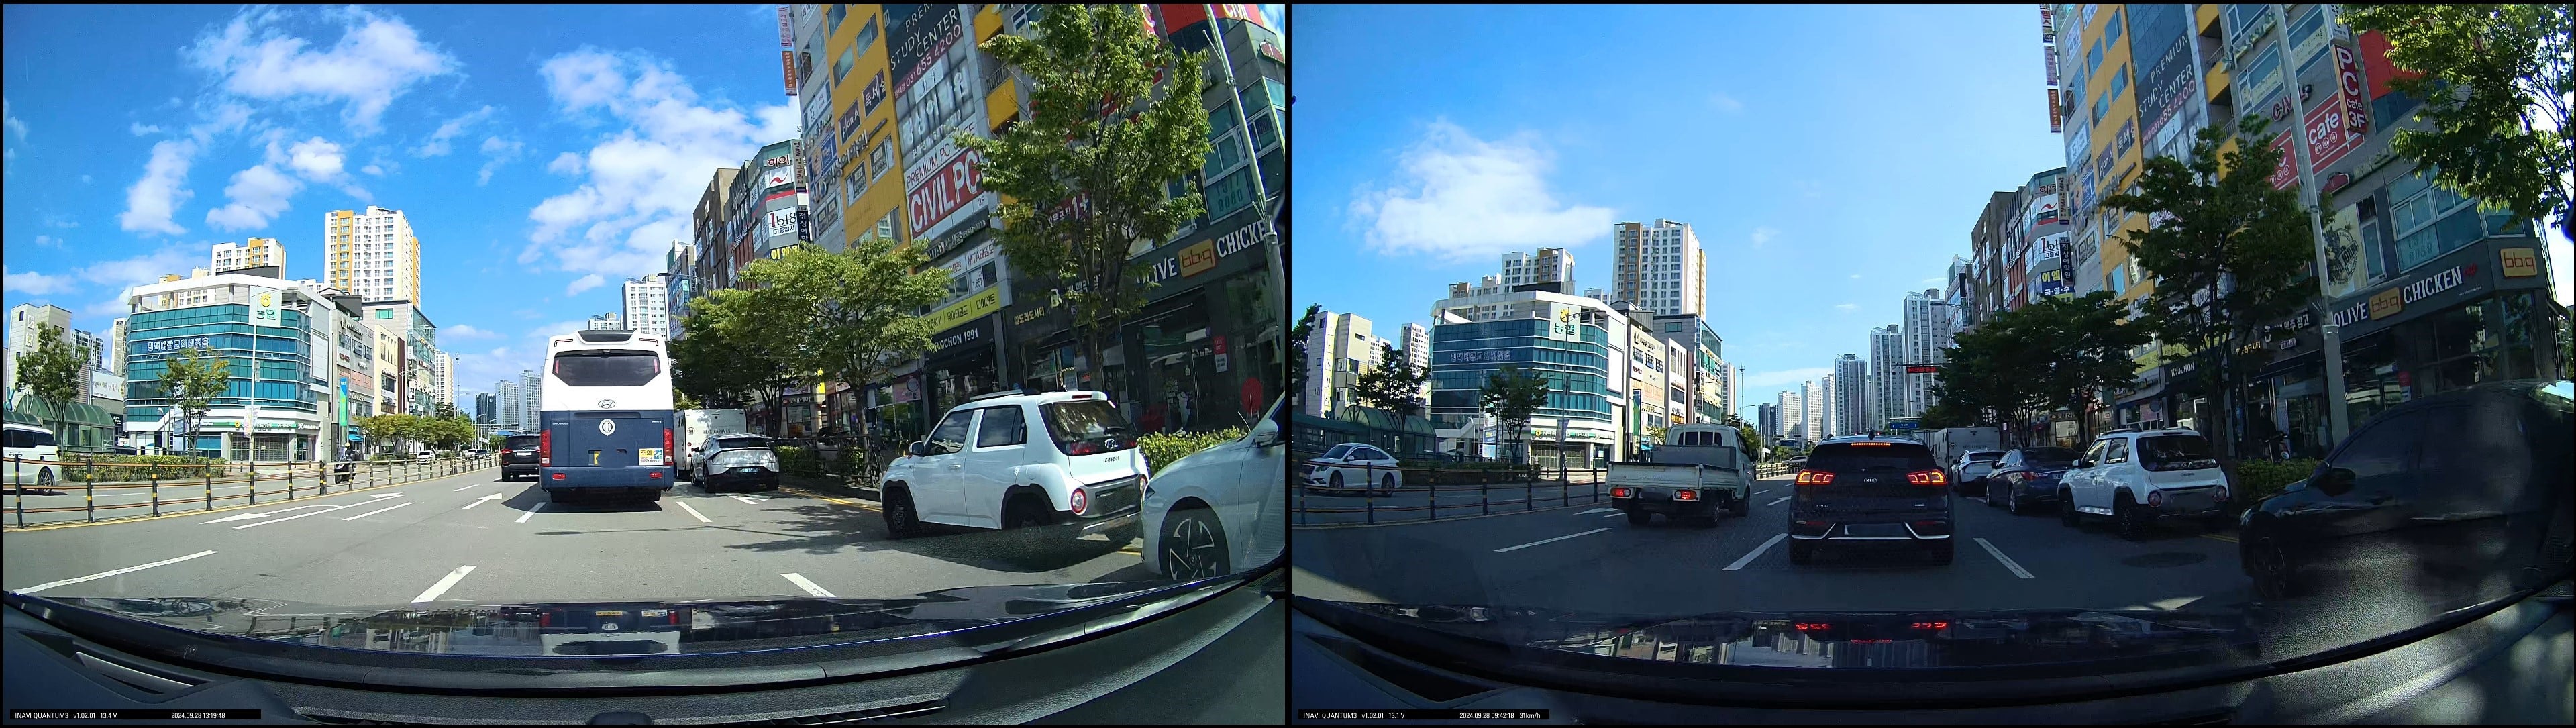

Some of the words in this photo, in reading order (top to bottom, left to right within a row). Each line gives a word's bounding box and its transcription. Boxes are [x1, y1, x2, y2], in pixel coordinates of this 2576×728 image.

[890, 27, 922, 70] STUDY
[915, 8, 958, 58] CENTER
[916, 52, 932, 76] 655
[933, 25, 961, 57] 4200
[2139, 80, 2163, 119] STUDY
[2159, 64, 2193, 109] CENTER
[2347, 99, 2363, 110] cafe
[2159, 107, 2173, 125] 655
[2308, 112, 2339, 144] cafe
[2349, 111, 2365, 128] 3F
[906, 153, 939, 189] PREMIUM
[911, 173, 954, 233] CIVIL
[953, 150, 980, 204] PC
[1217, 219, 1266, 258] CHICKE
[256, 309, 276, 321] 농협
[2333, 302, 2368, 328] OLIVE
[2403, 266, 2463, 304] CHICKEN
[963, 327, 978, 342] 1991
